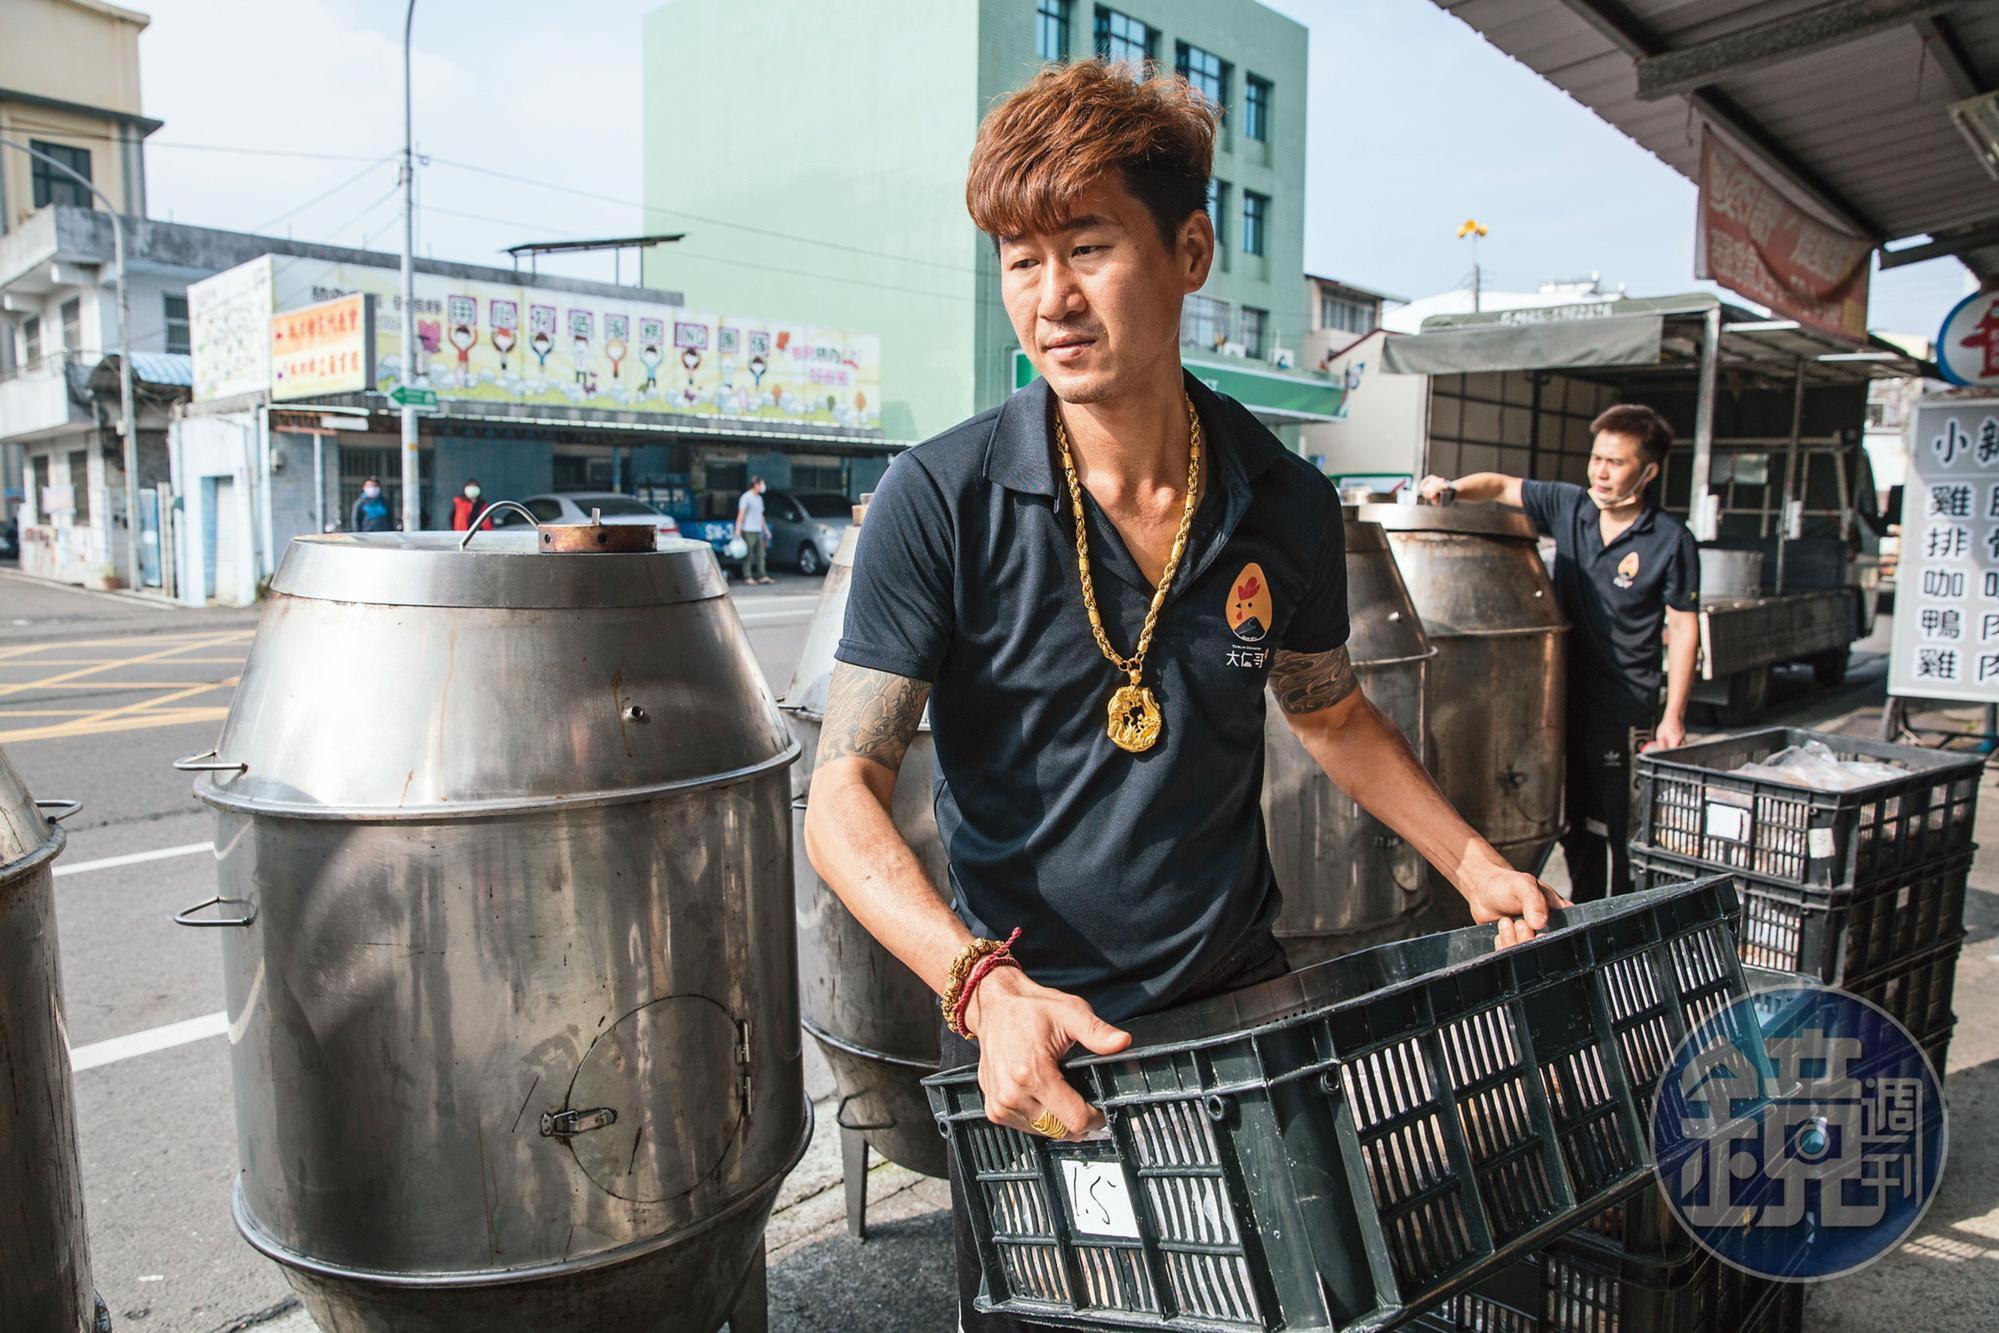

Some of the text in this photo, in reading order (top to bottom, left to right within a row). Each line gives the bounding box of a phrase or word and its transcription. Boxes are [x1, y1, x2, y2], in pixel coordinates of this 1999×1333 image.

[1930, 485, 1999, 517] 雞
[1226, 651, 1265, 668] 大仁哥
